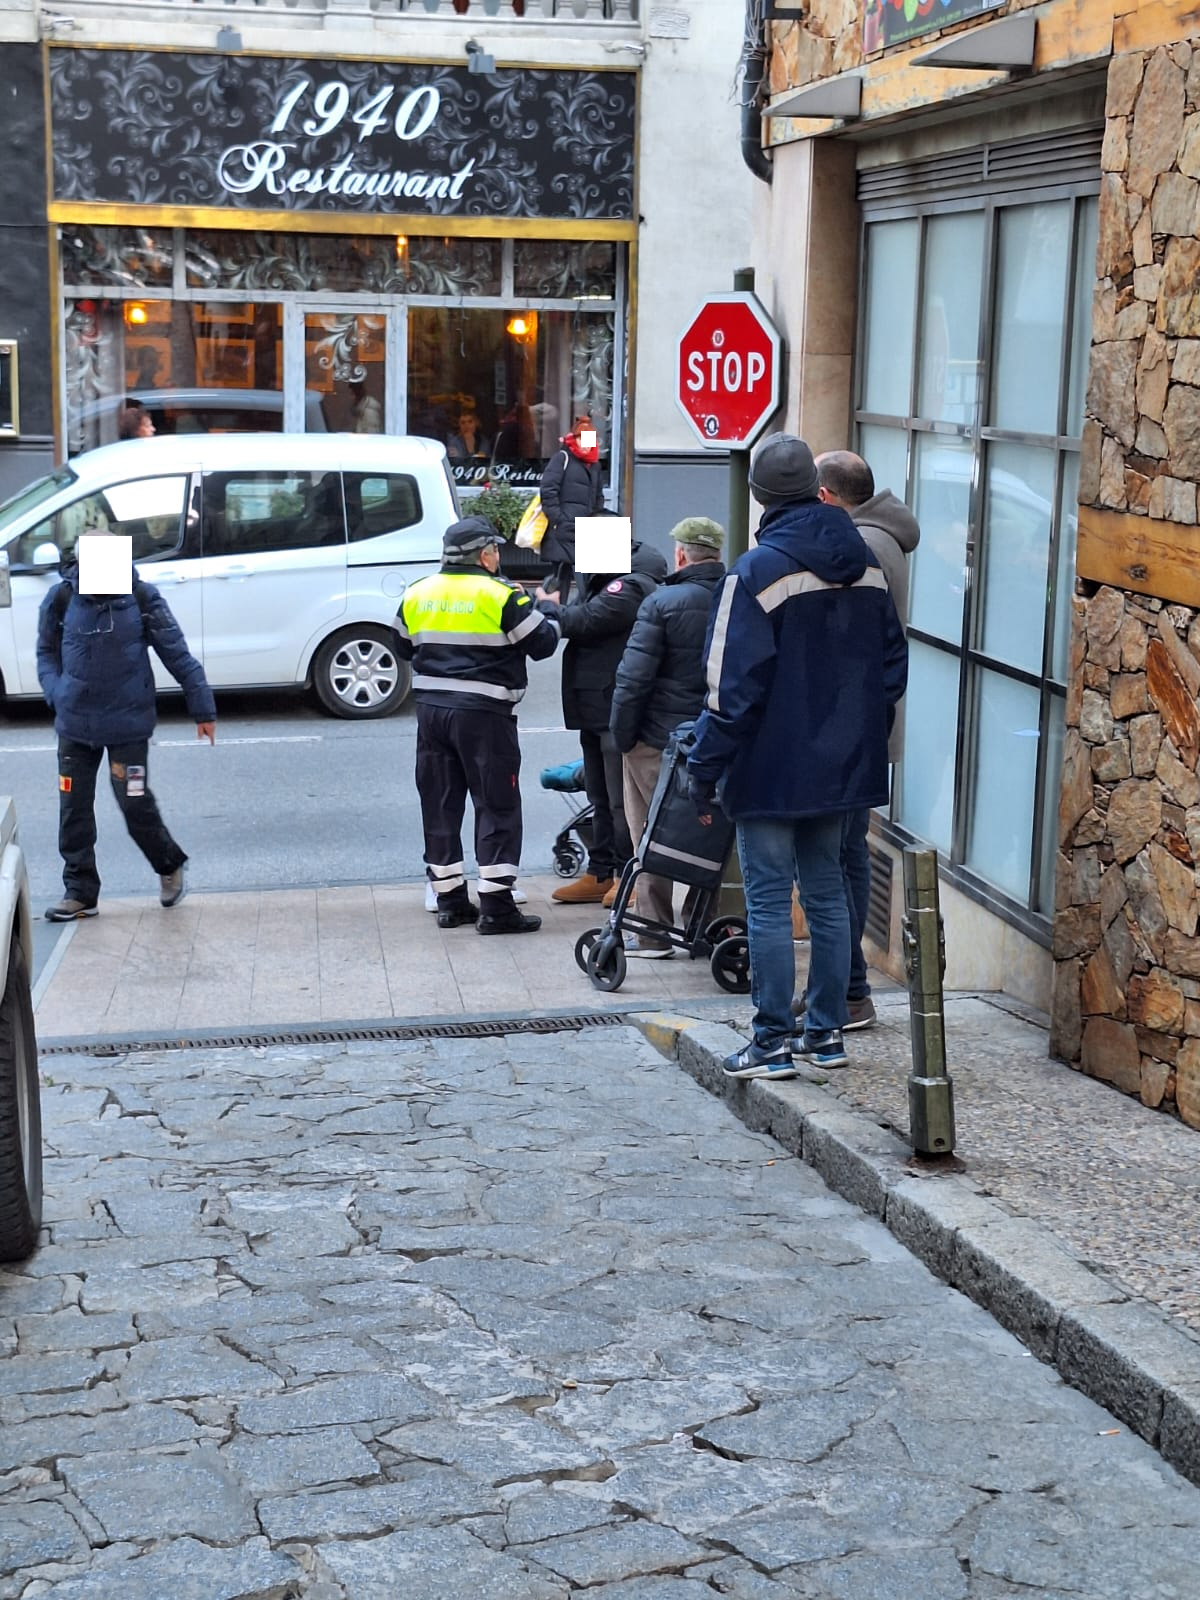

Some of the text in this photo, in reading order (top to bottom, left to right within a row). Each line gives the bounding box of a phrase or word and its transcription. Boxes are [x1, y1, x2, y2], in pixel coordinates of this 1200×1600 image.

[270, 80, 441, 143] 1940
[217, 141, 476, 200] Restaurant
[686, 351, 766, 393] STOP
[487, 464, 544, 481] Restau
